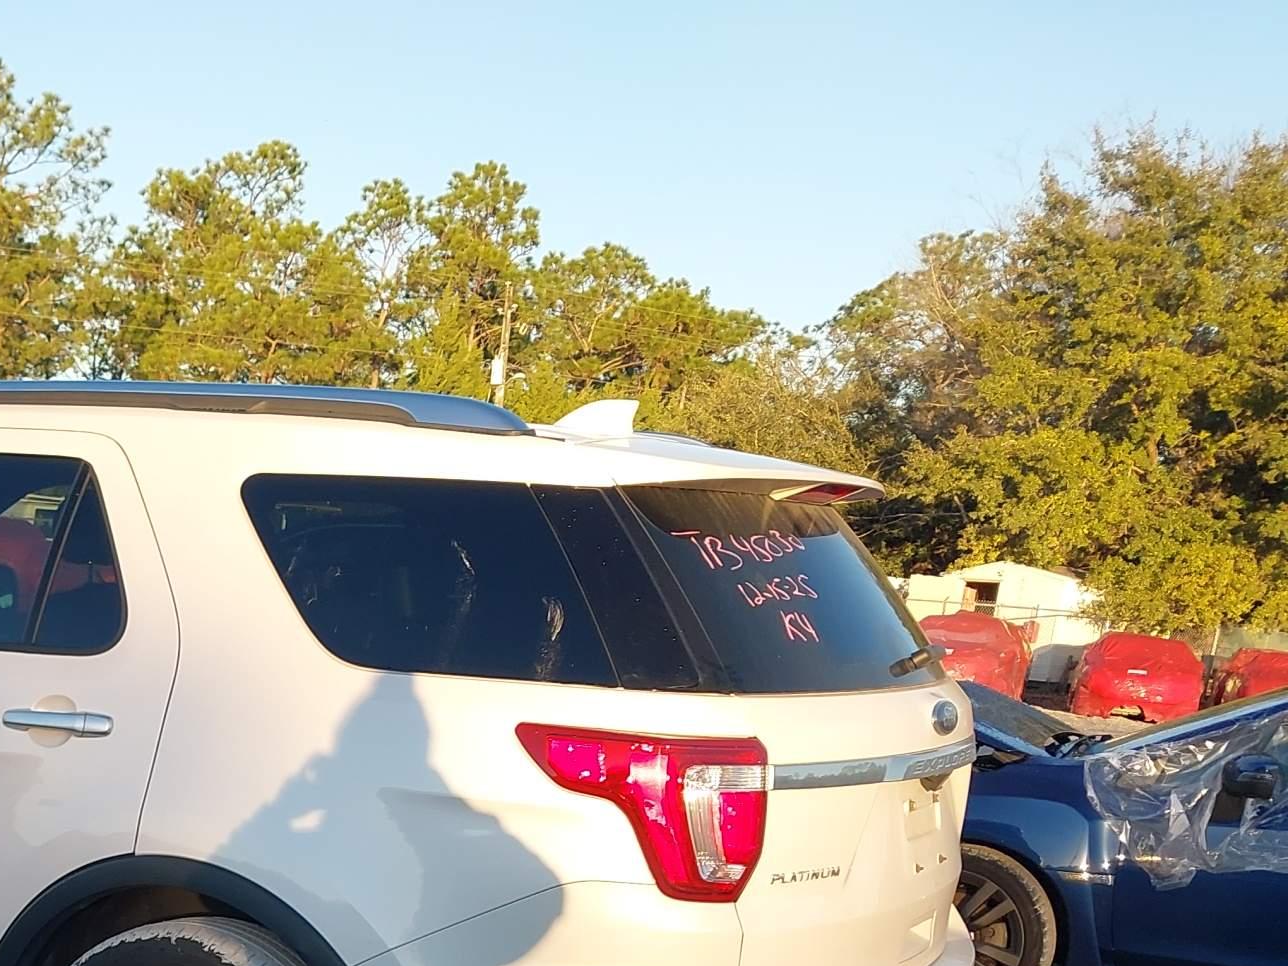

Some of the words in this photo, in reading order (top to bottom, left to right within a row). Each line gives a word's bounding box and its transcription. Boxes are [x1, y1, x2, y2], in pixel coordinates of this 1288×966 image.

[780, 610, 819, 642] K4
[912, 748, 972, 774] EXPLORE
[770, 866, 841, 885] PLATINUM
